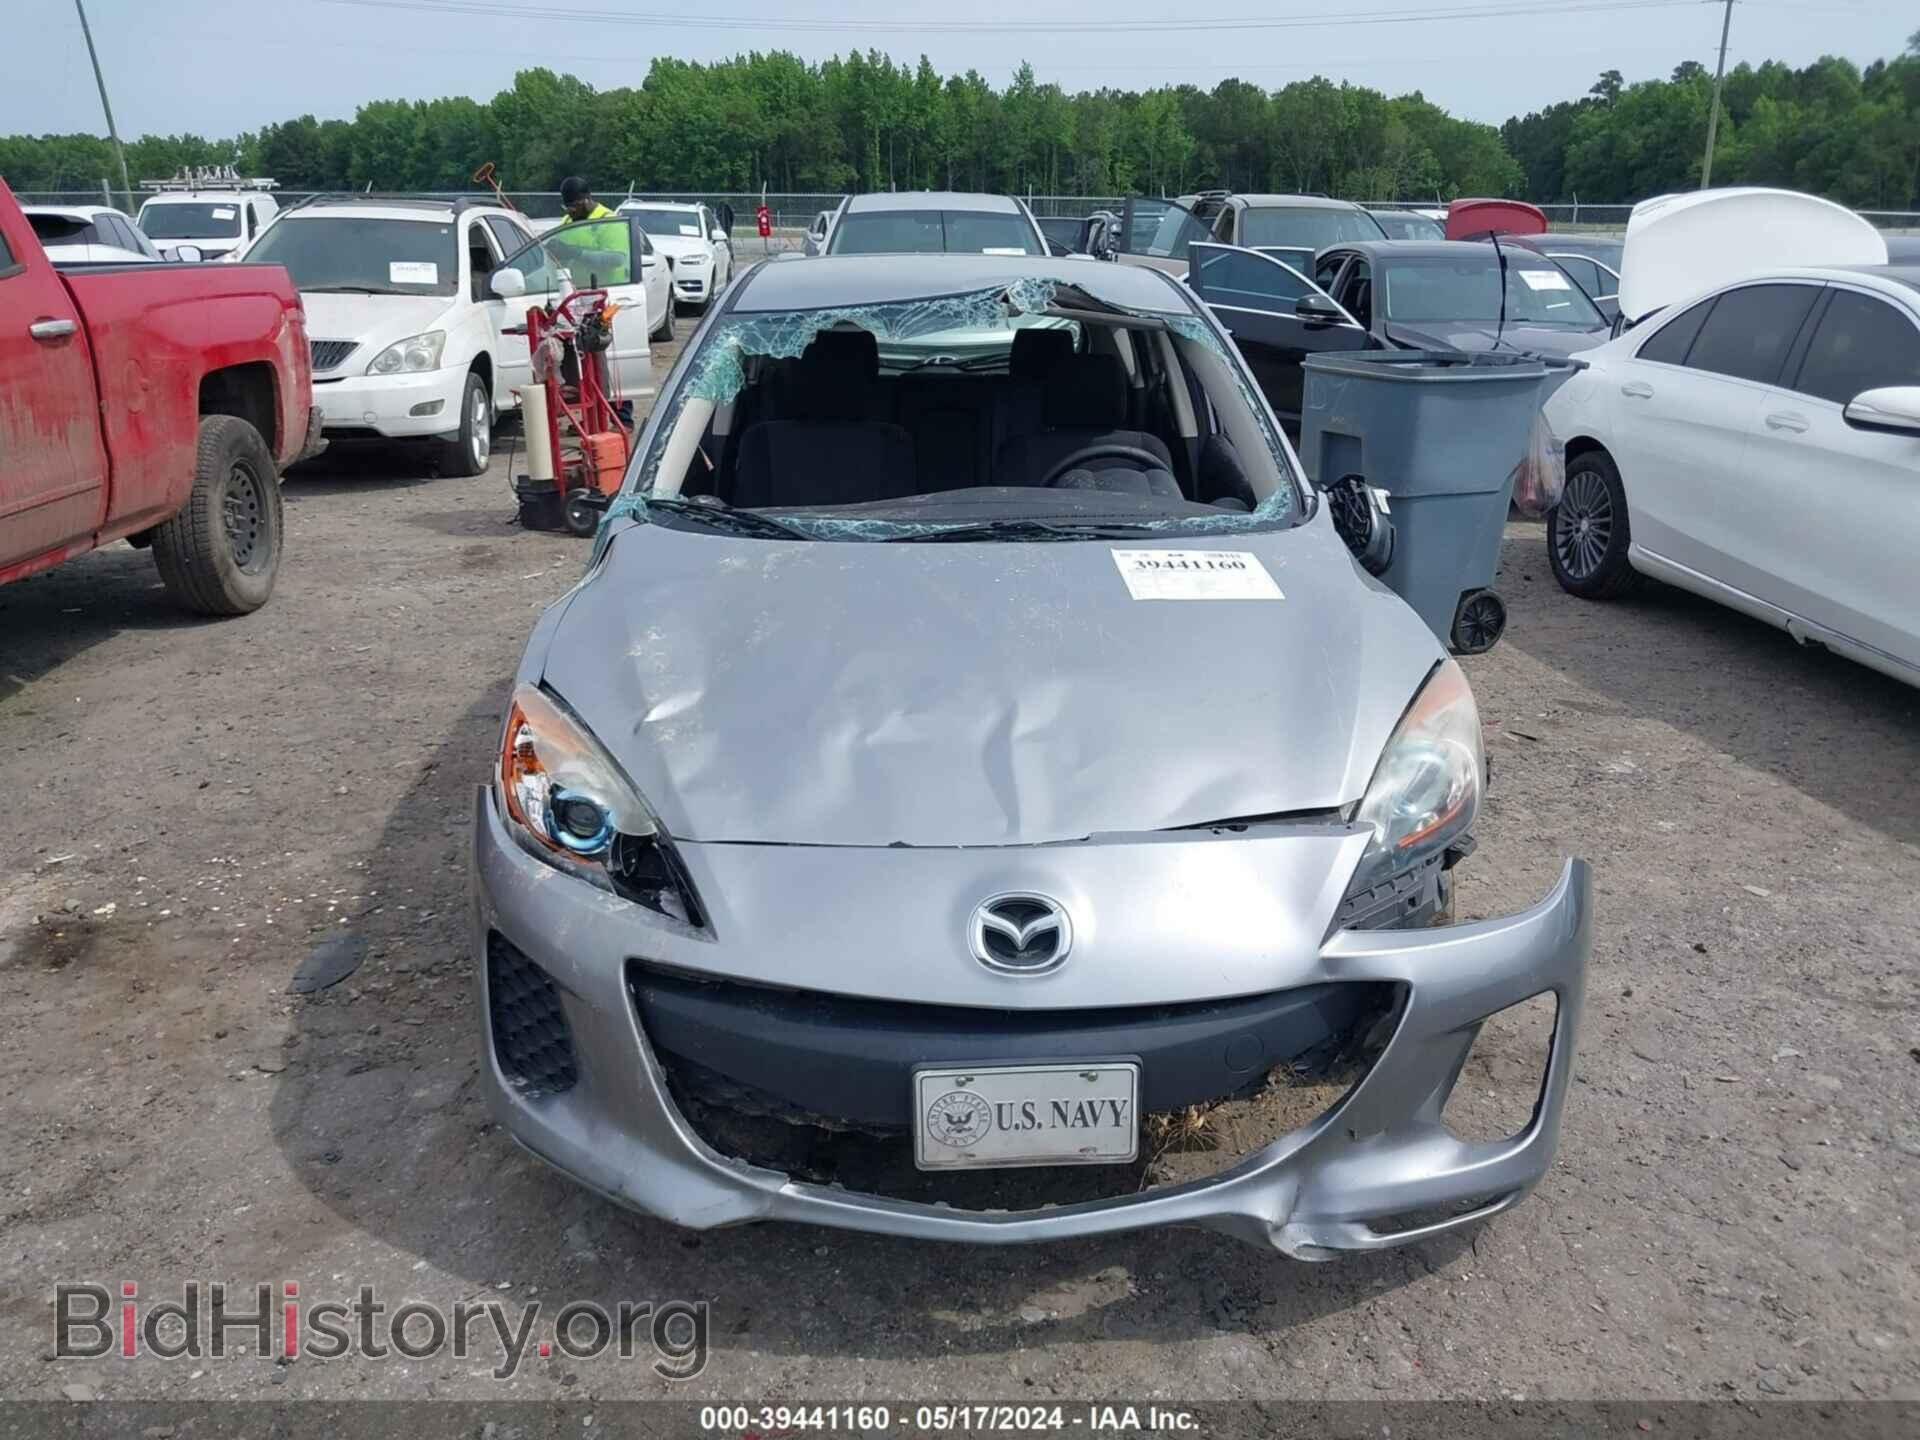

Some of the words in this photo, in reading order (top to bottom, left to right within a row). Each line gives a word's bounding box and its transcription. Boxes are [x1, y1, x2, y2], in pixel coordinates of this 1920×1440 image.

[1135, 559, 1247, 570] 39441160
[994, 1101, 1042, 1131] U.S.
[1049, 1098, 1128, 1129] NAVY
